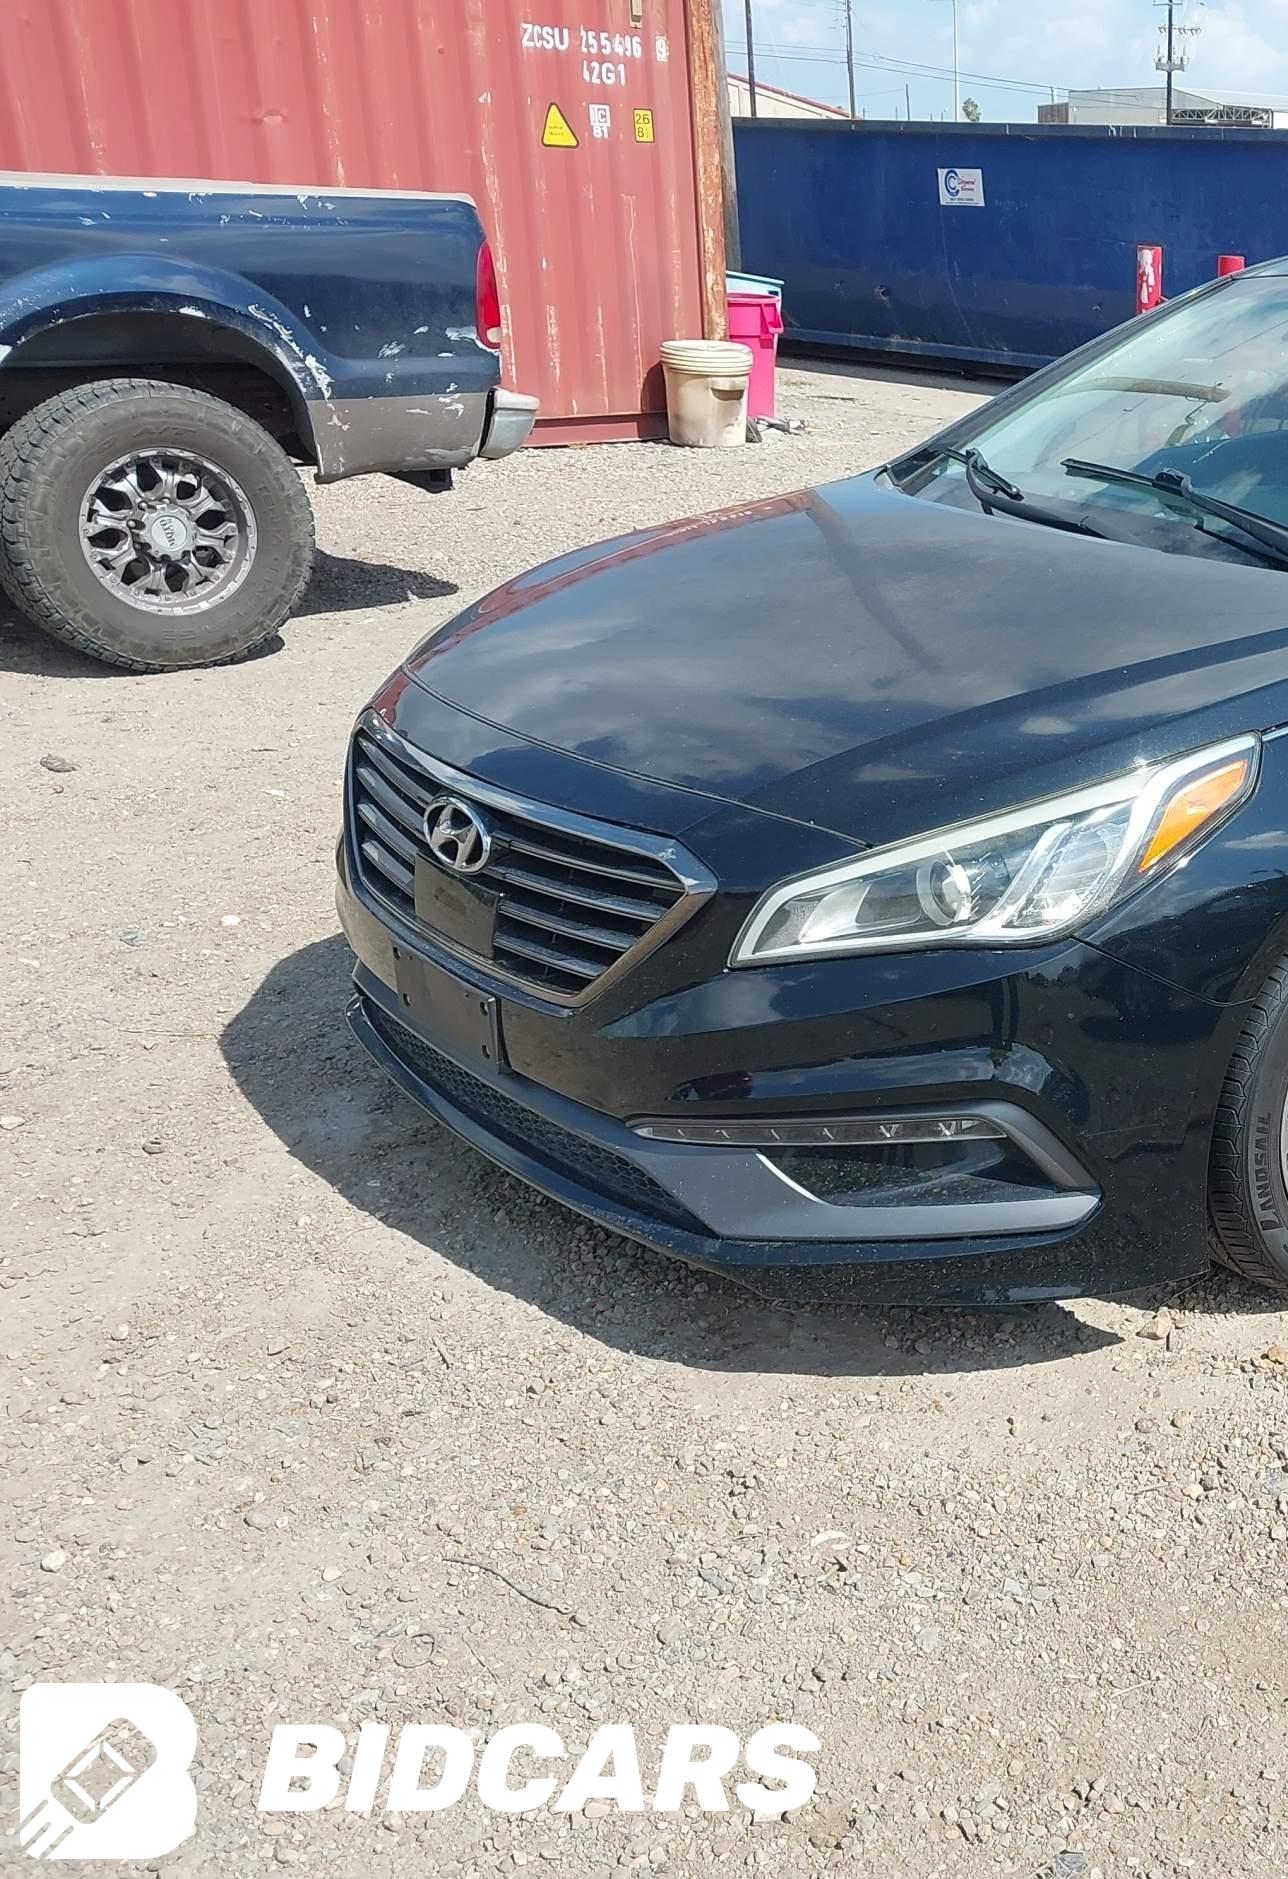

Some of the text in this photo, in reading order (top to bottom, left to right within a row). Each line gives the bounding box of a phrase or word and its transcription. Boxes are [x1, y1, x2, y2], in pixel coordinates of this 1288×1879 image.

[521, 23, 570, 51] ZCSU
[580, 25, 643, 59] 255496
[583, 60, 627, 86] 42G1
[1254, 1111, 1284, 1232] LANDSAIL
